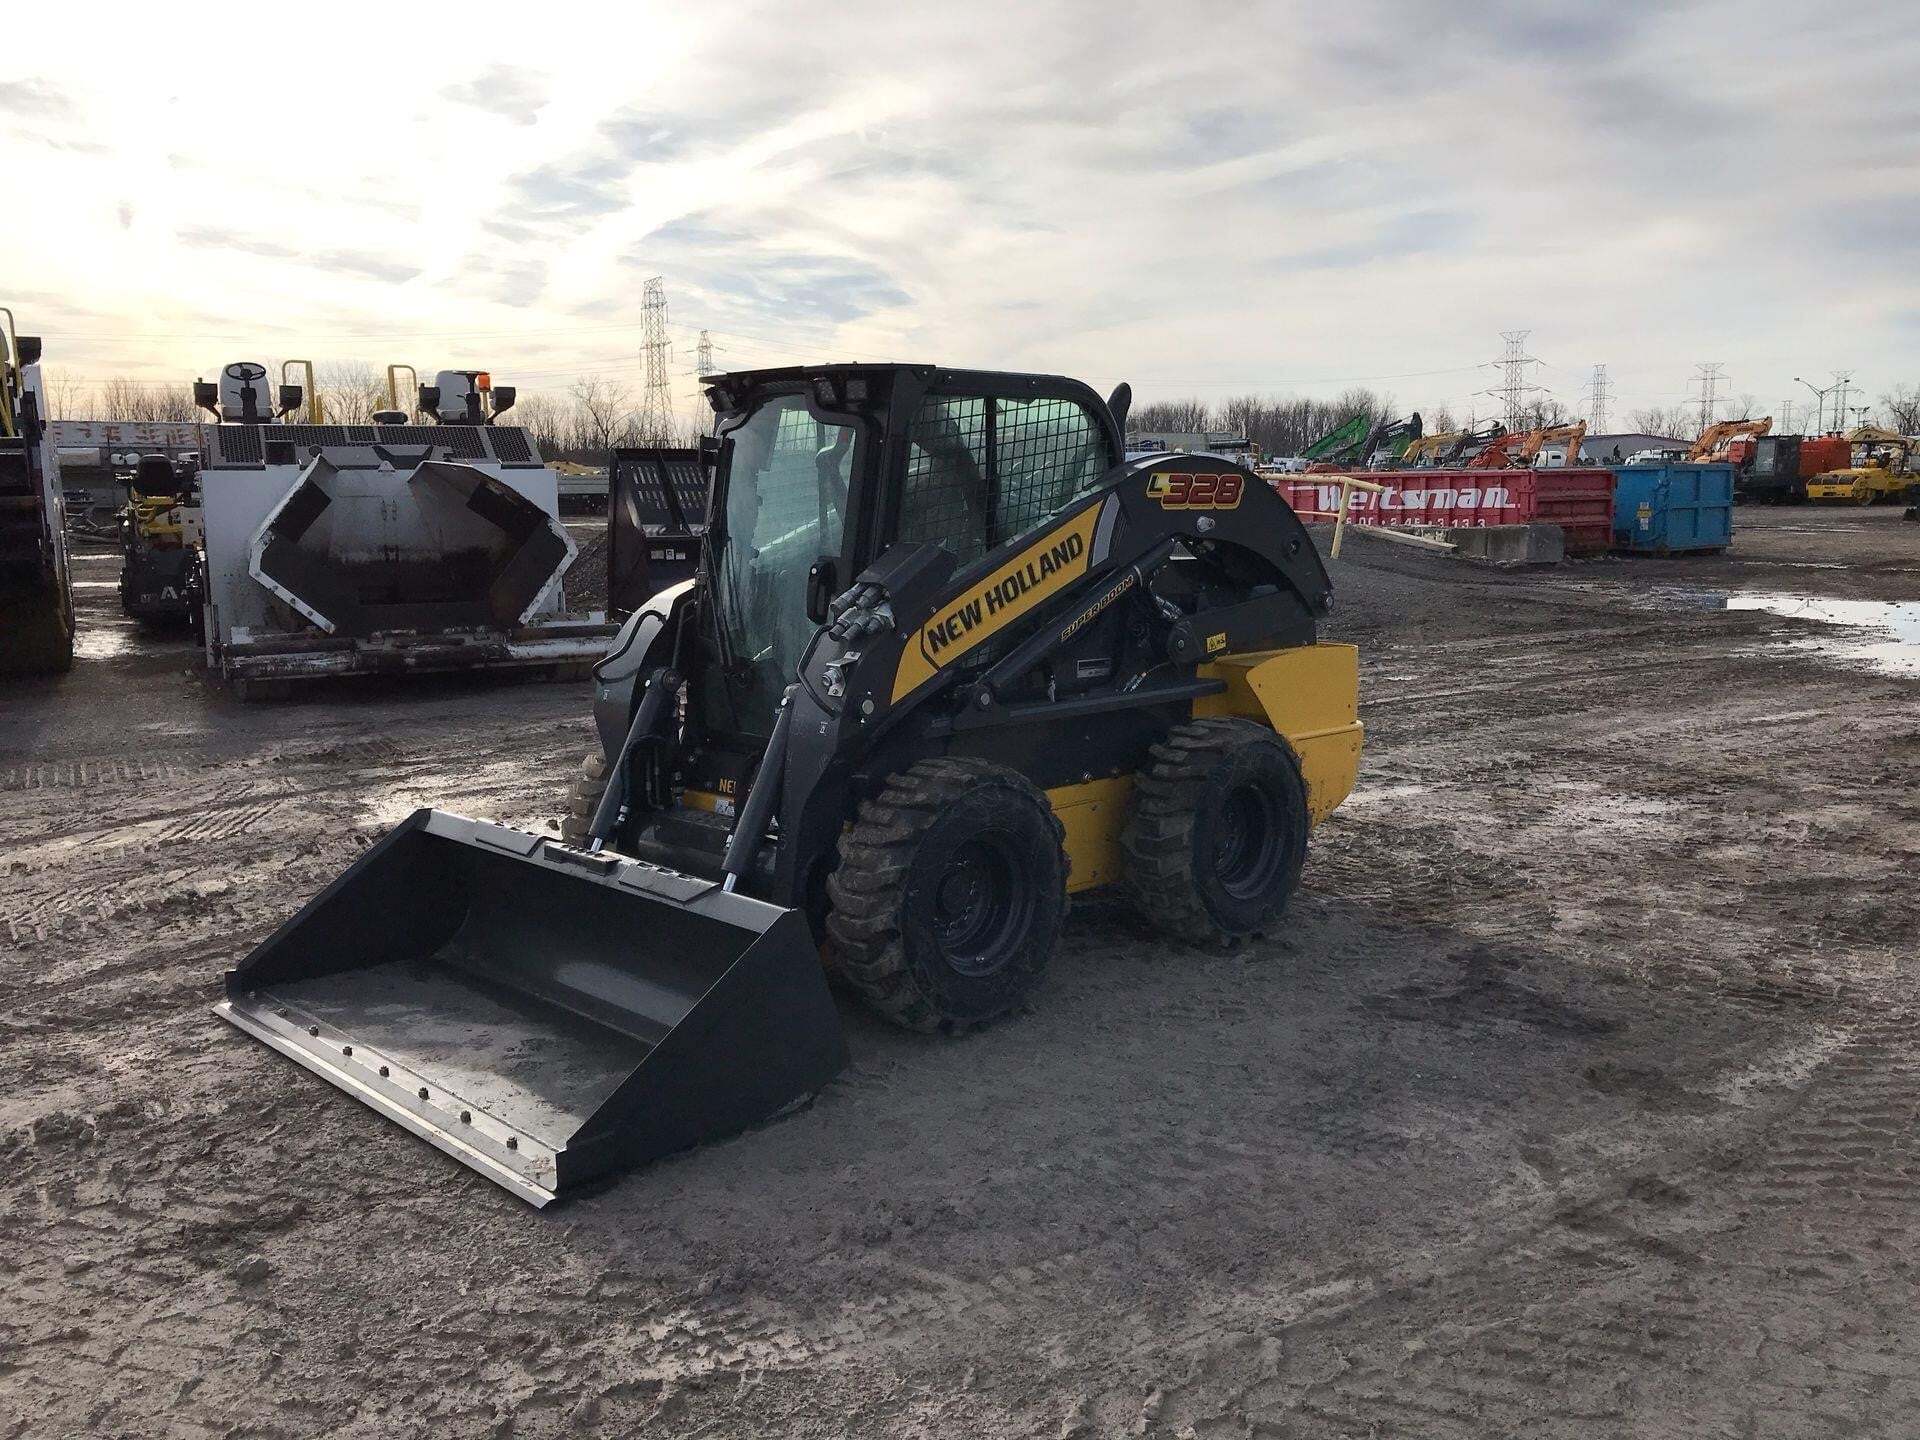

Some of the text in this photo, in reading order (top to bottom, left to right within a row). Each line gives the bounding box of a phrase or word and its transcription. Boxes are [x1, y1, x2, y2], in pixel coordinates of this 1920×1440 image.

[927, 532, 1084, 654] NEW HOLLAND
[1061, 602, 1100, 641] SUPER
[719, 778, 737, 793] NE
